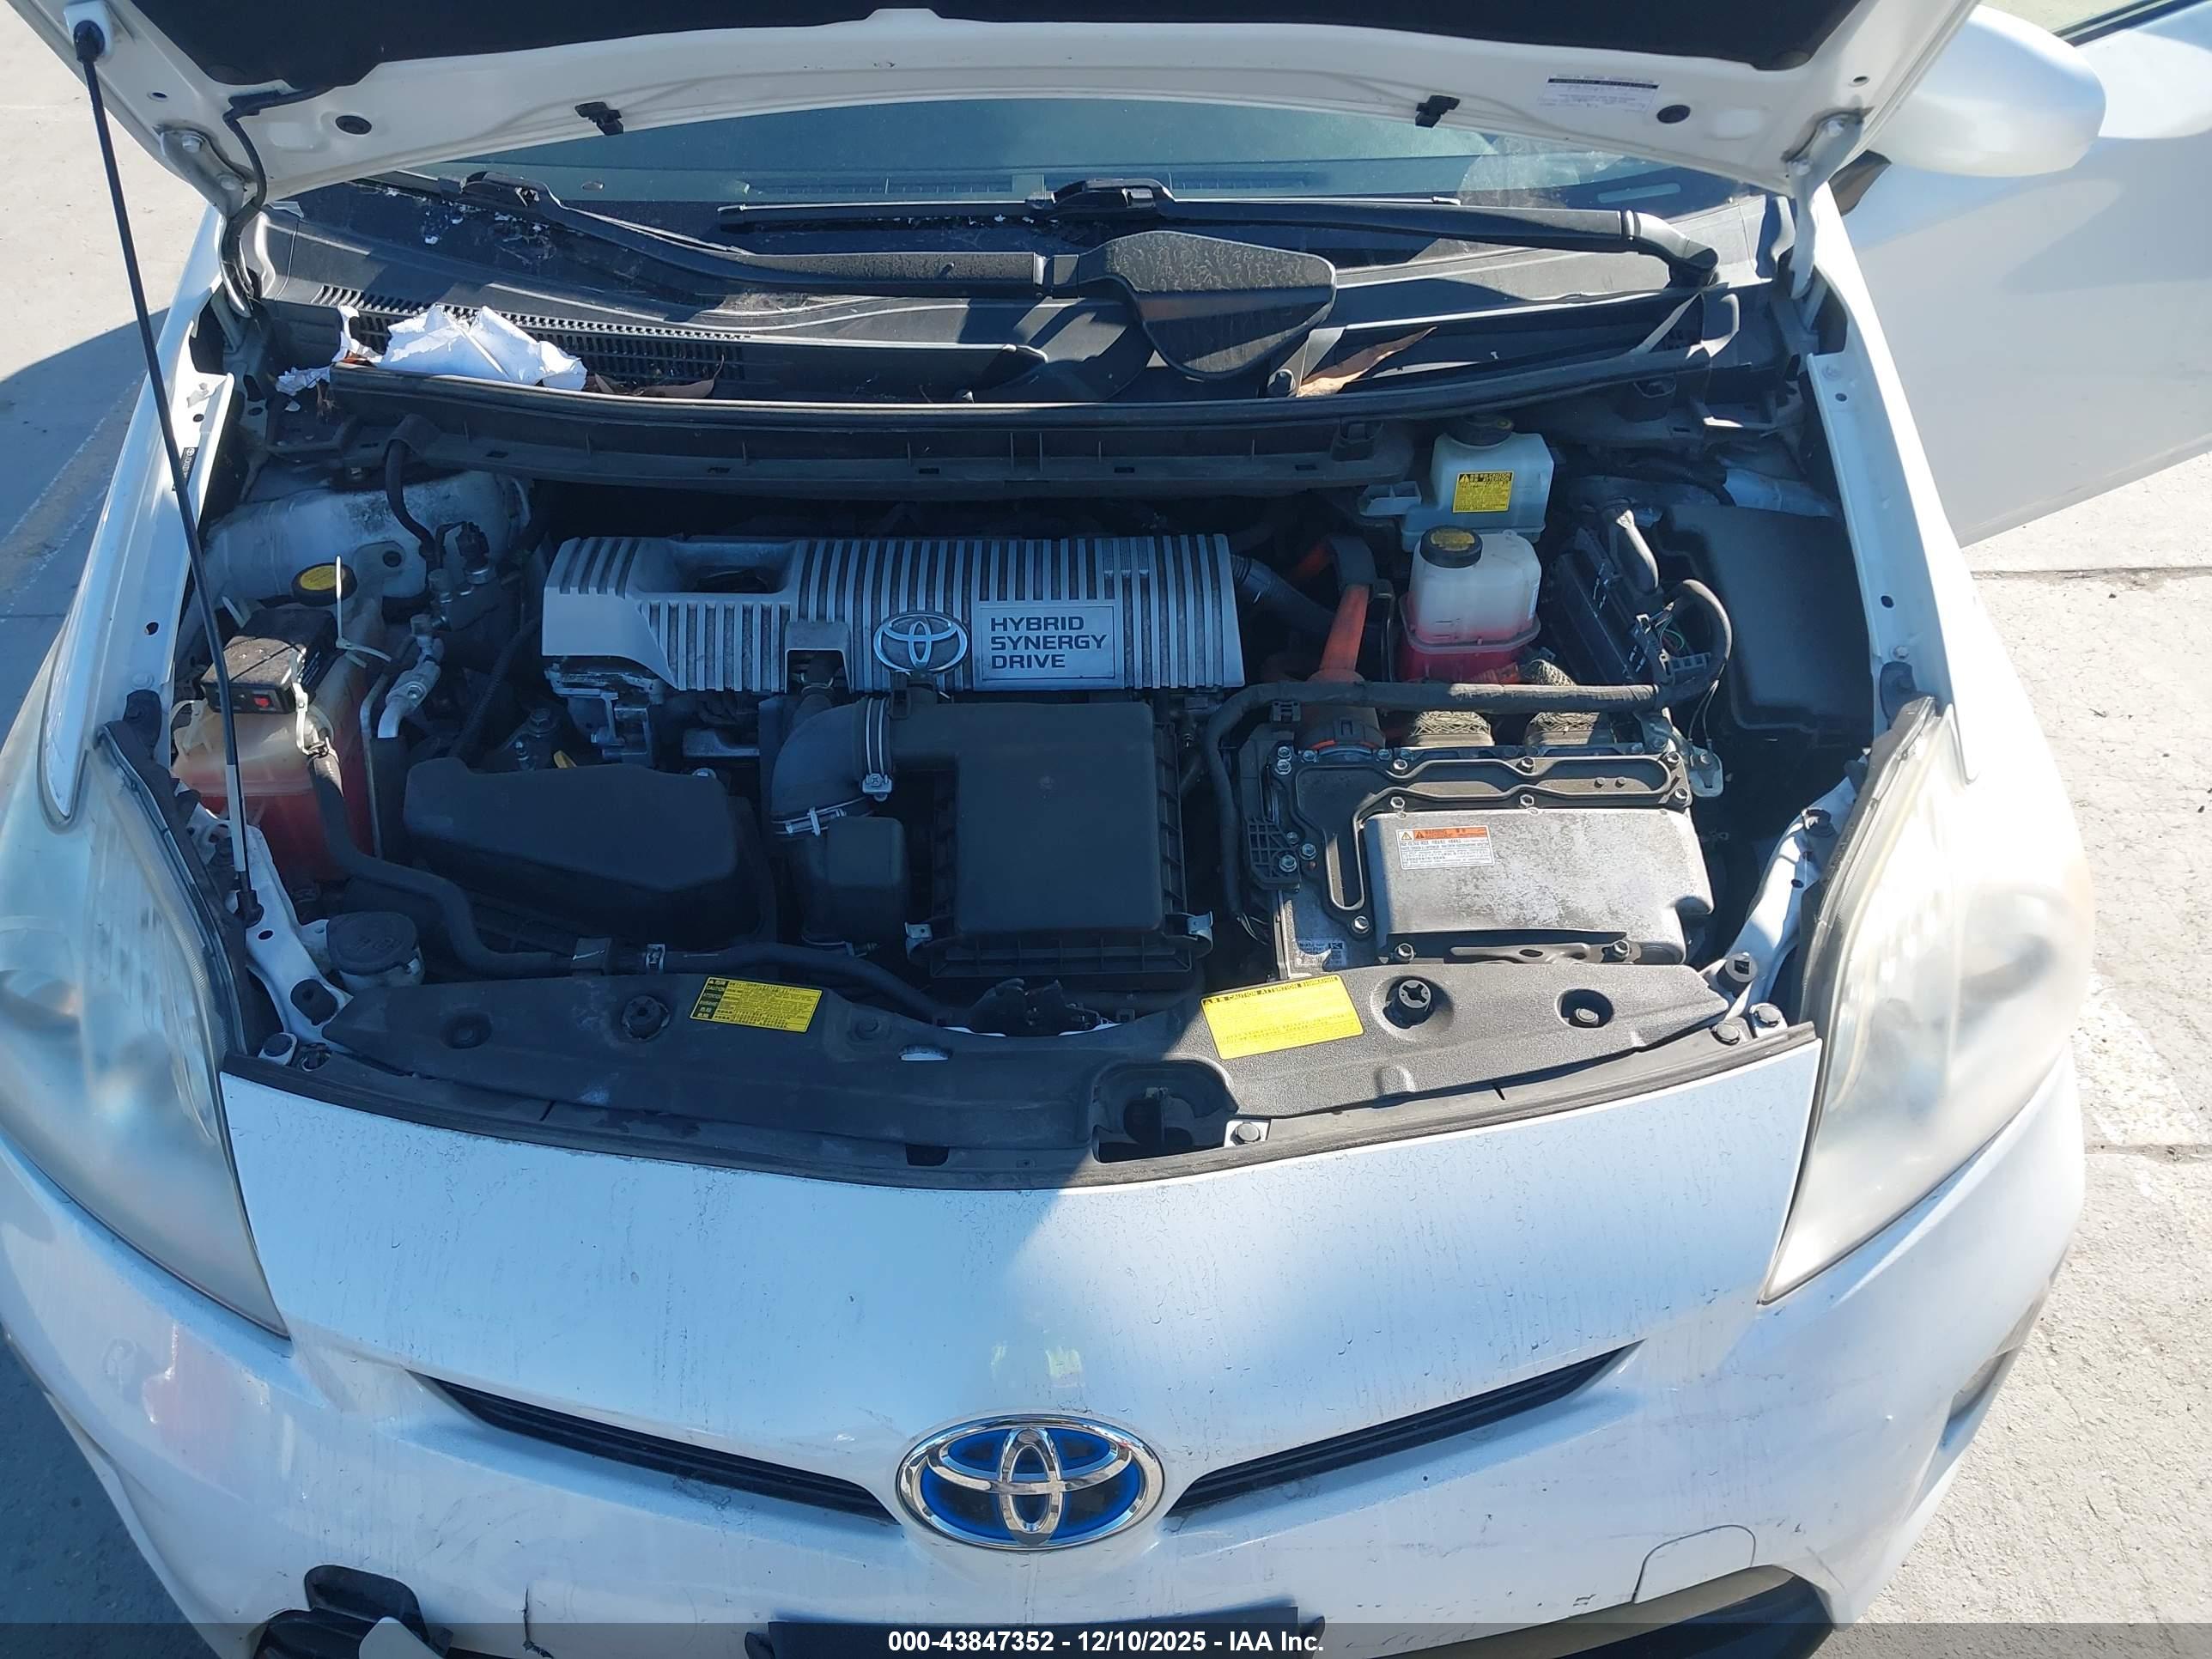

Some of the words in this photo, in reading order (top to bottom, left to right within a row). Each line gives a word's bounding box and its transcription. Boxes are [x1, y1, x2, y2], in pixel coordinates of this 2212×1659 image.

[990, 617, 1085, 632] HYBRID
[990, 634, 1108, 651] SYNERGY
[991, 653, 1066, 669] DRIVE
